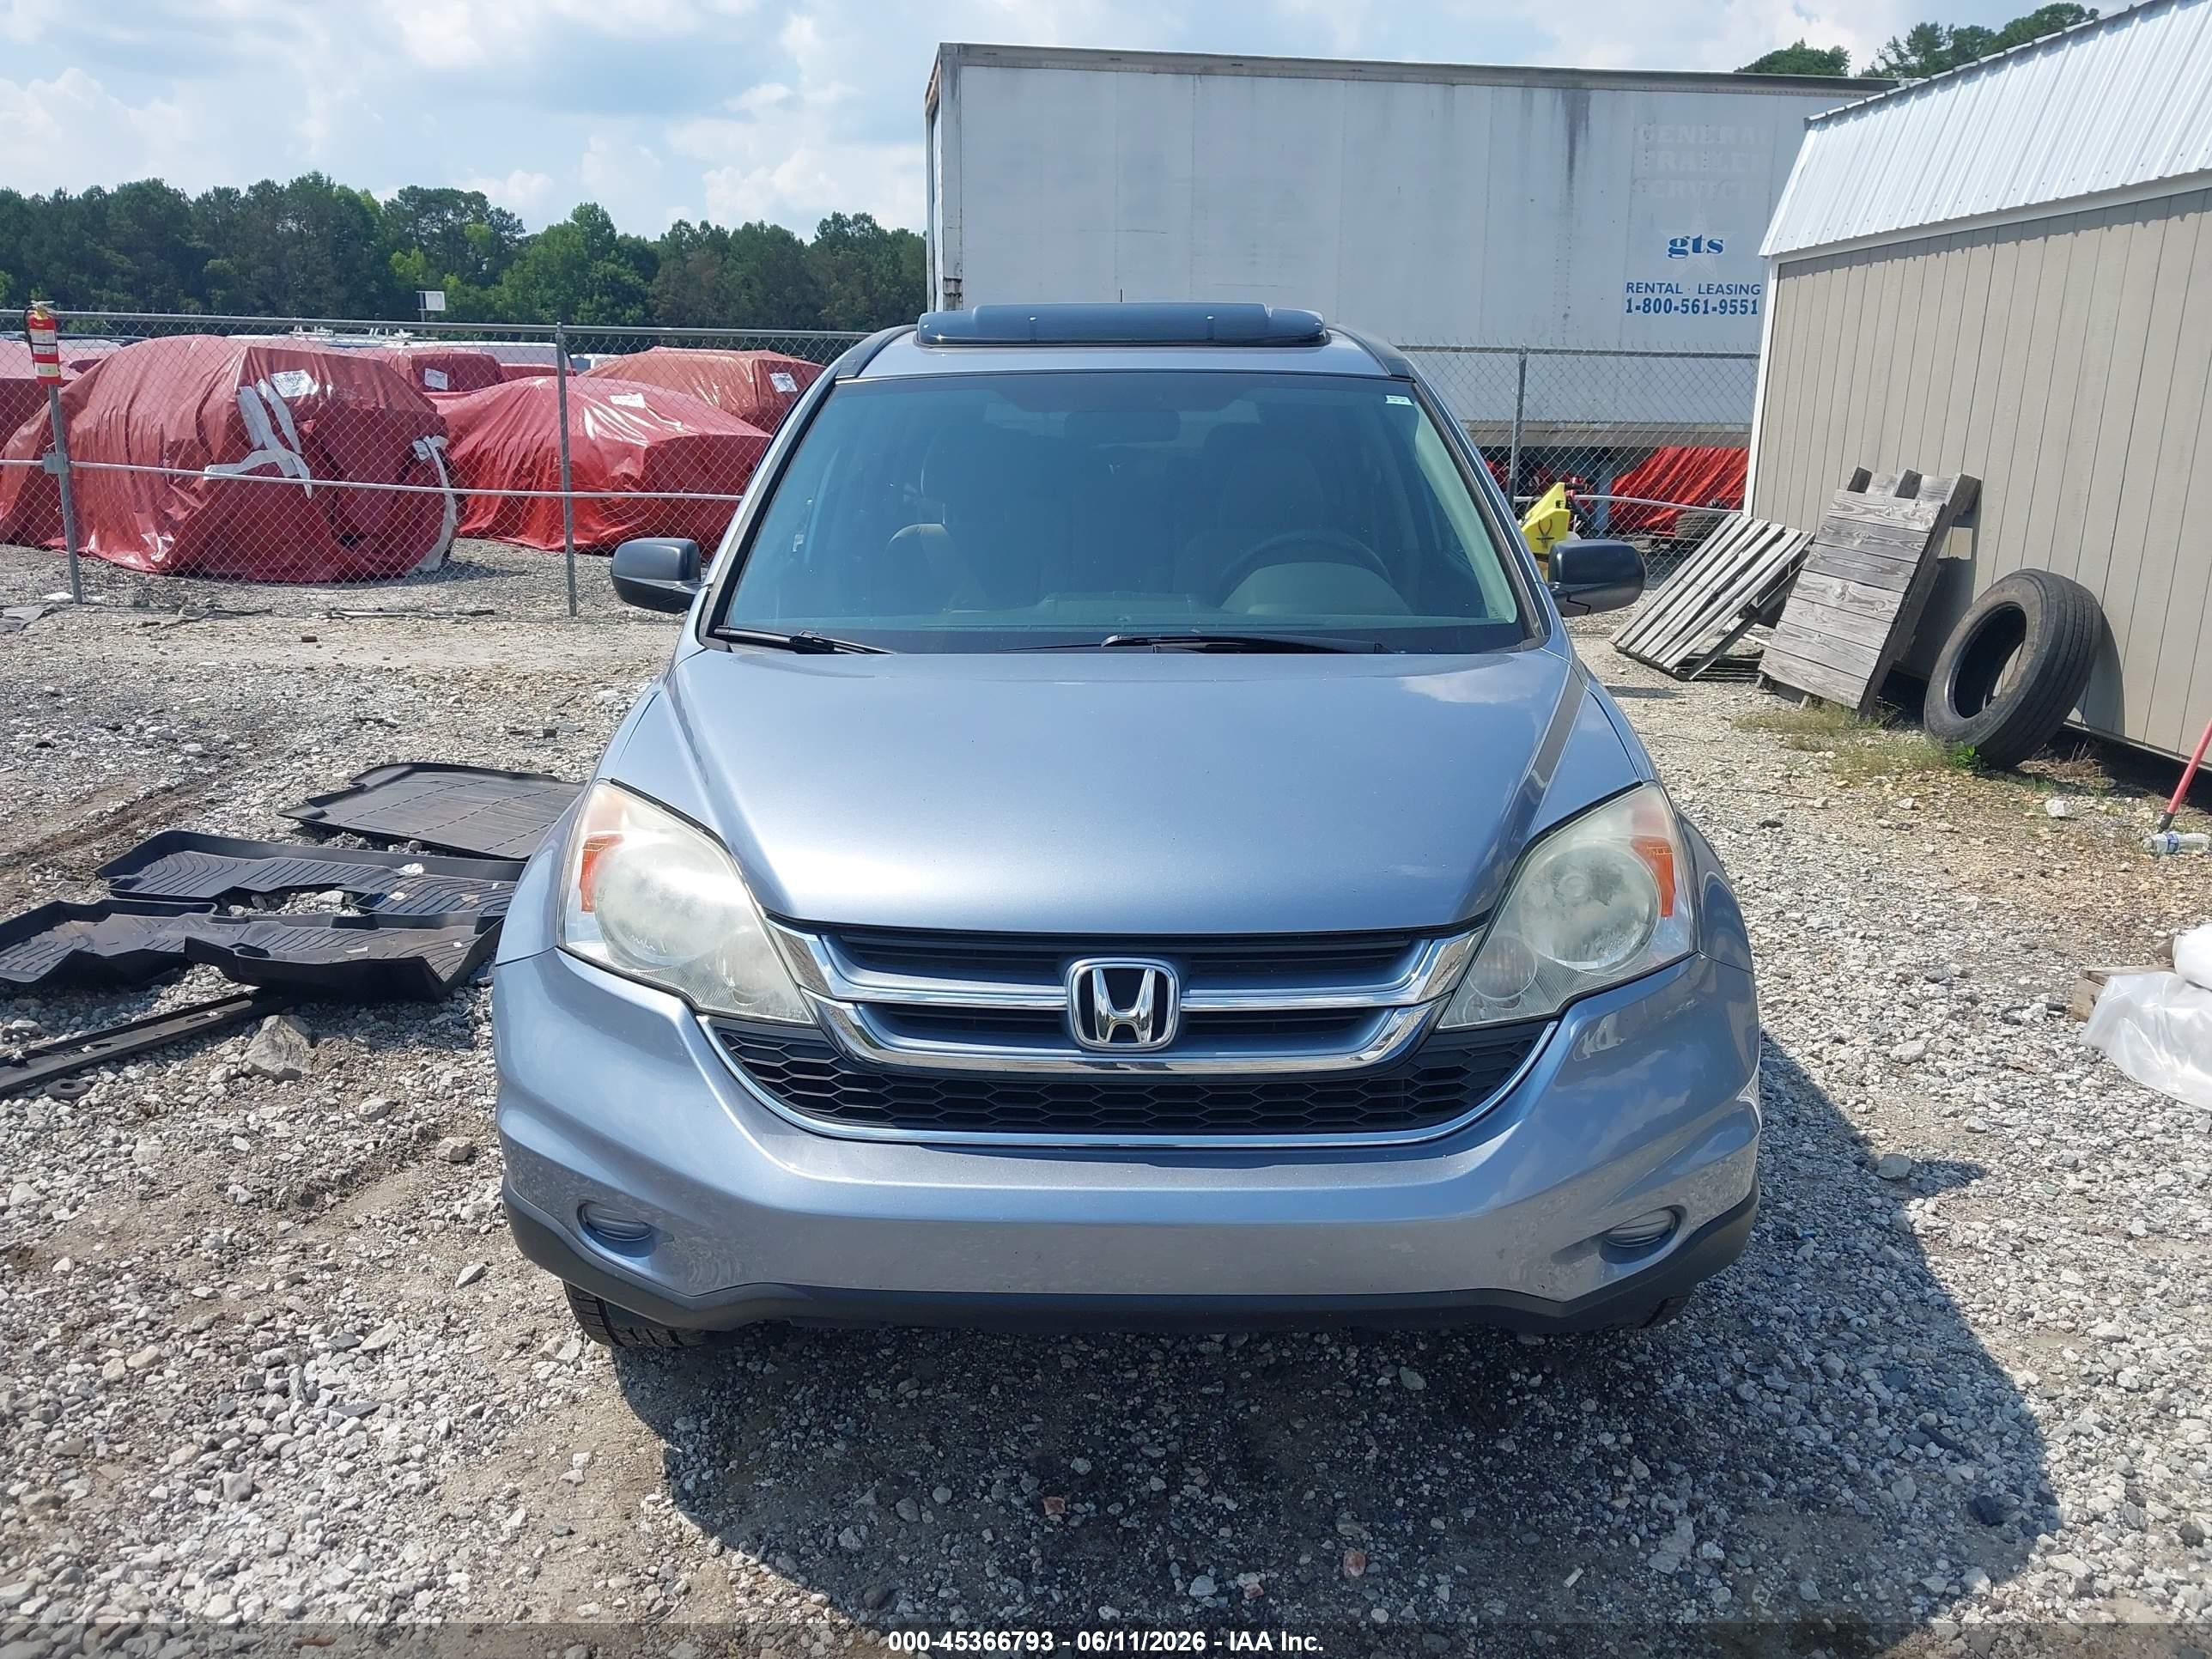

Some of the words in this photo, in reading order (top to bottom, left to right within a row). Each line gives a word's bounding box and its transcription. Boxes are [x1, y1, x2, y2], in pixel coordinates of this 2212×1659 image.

[1668, 234, 1724, 259] gts
[1626, 282, 1684, 295] RENTAL
[1698, 283, 1762, 295] LEASING
[1626, 297, 1759, 315] 1-800-561-9551
